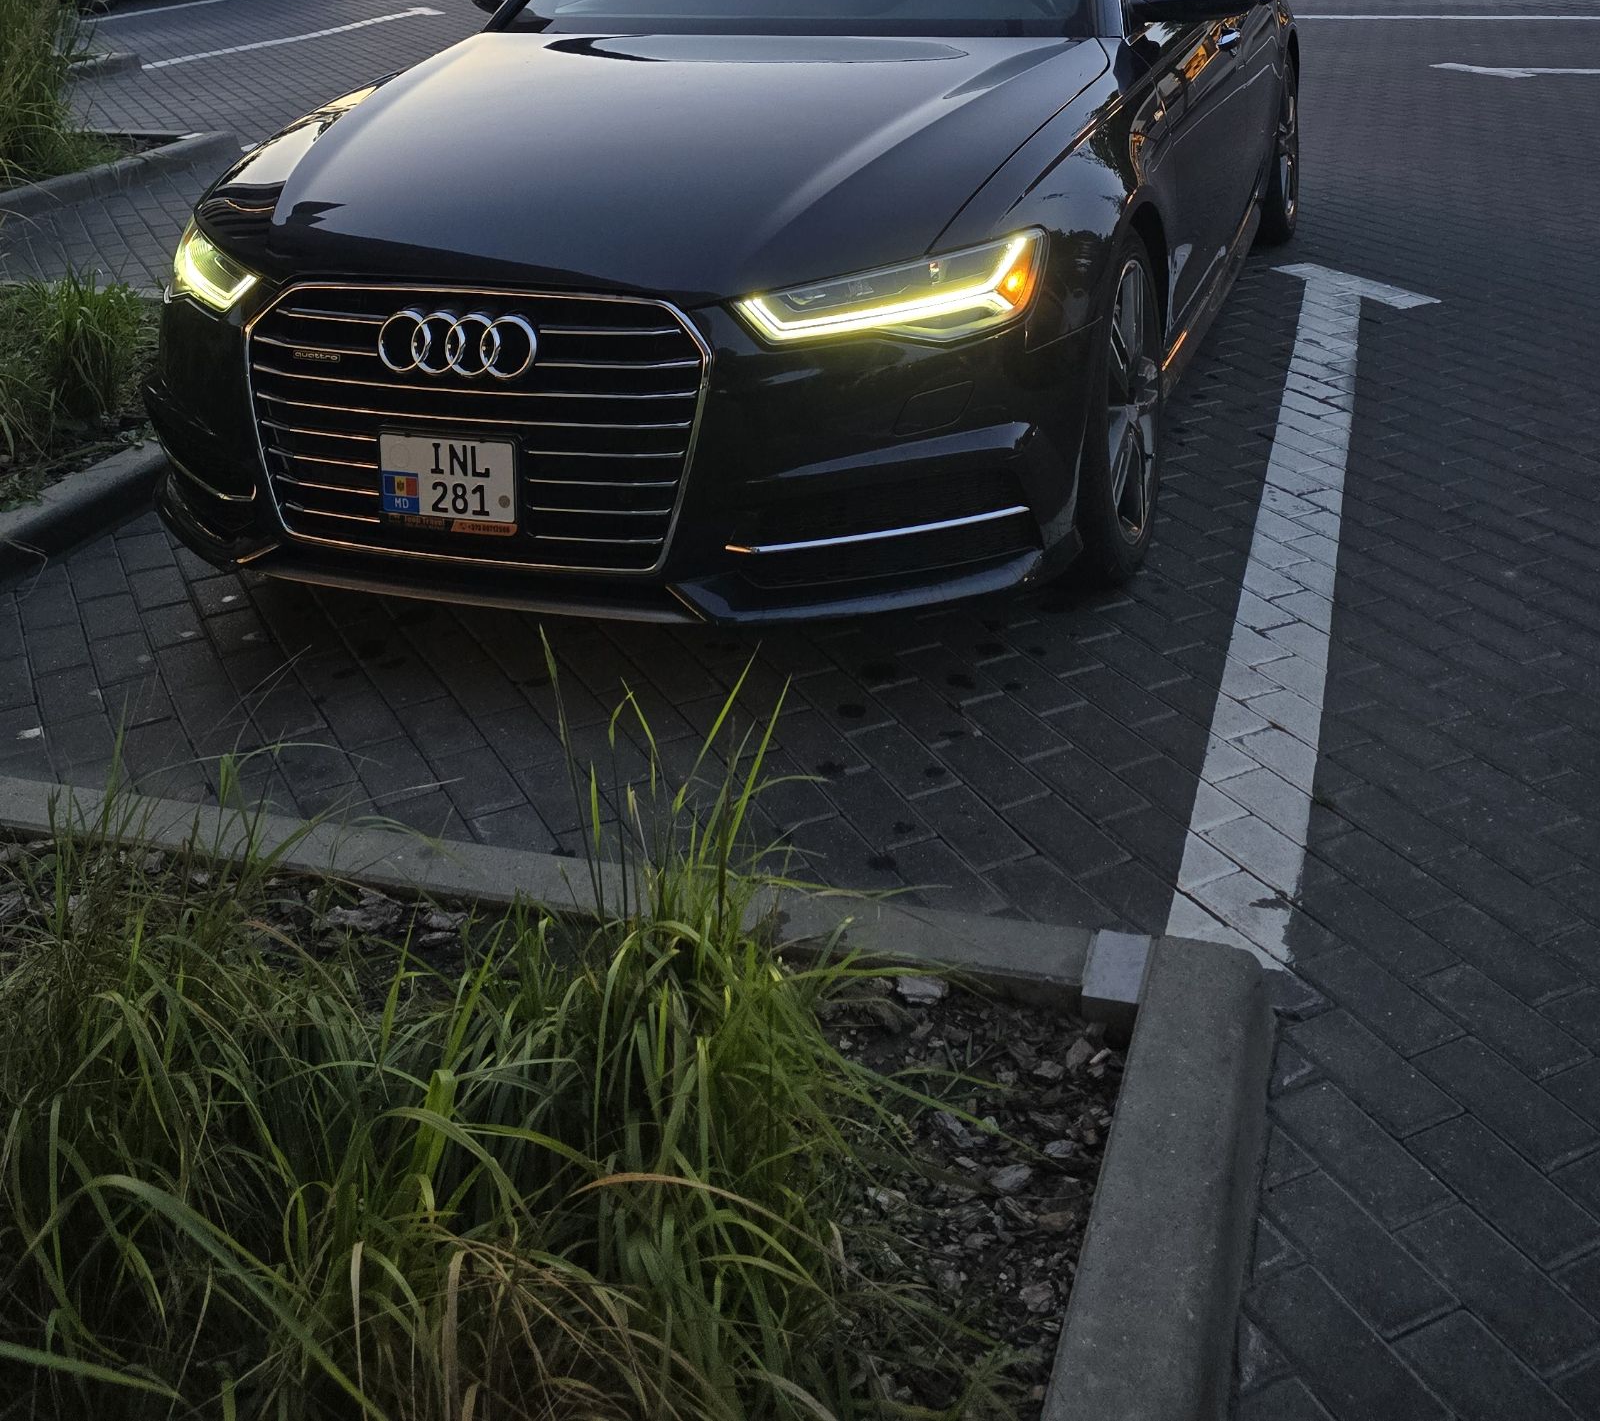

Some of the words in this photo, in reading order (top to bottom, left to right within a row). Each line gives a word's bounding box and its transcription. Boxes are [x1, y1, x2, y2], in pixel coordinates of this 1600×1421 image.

[294, 351, 338, 361] quattro
[430, 442, 490, 478] INL
[394, 497, 409, 509] MD
[431, 481, 490, 517] 281
